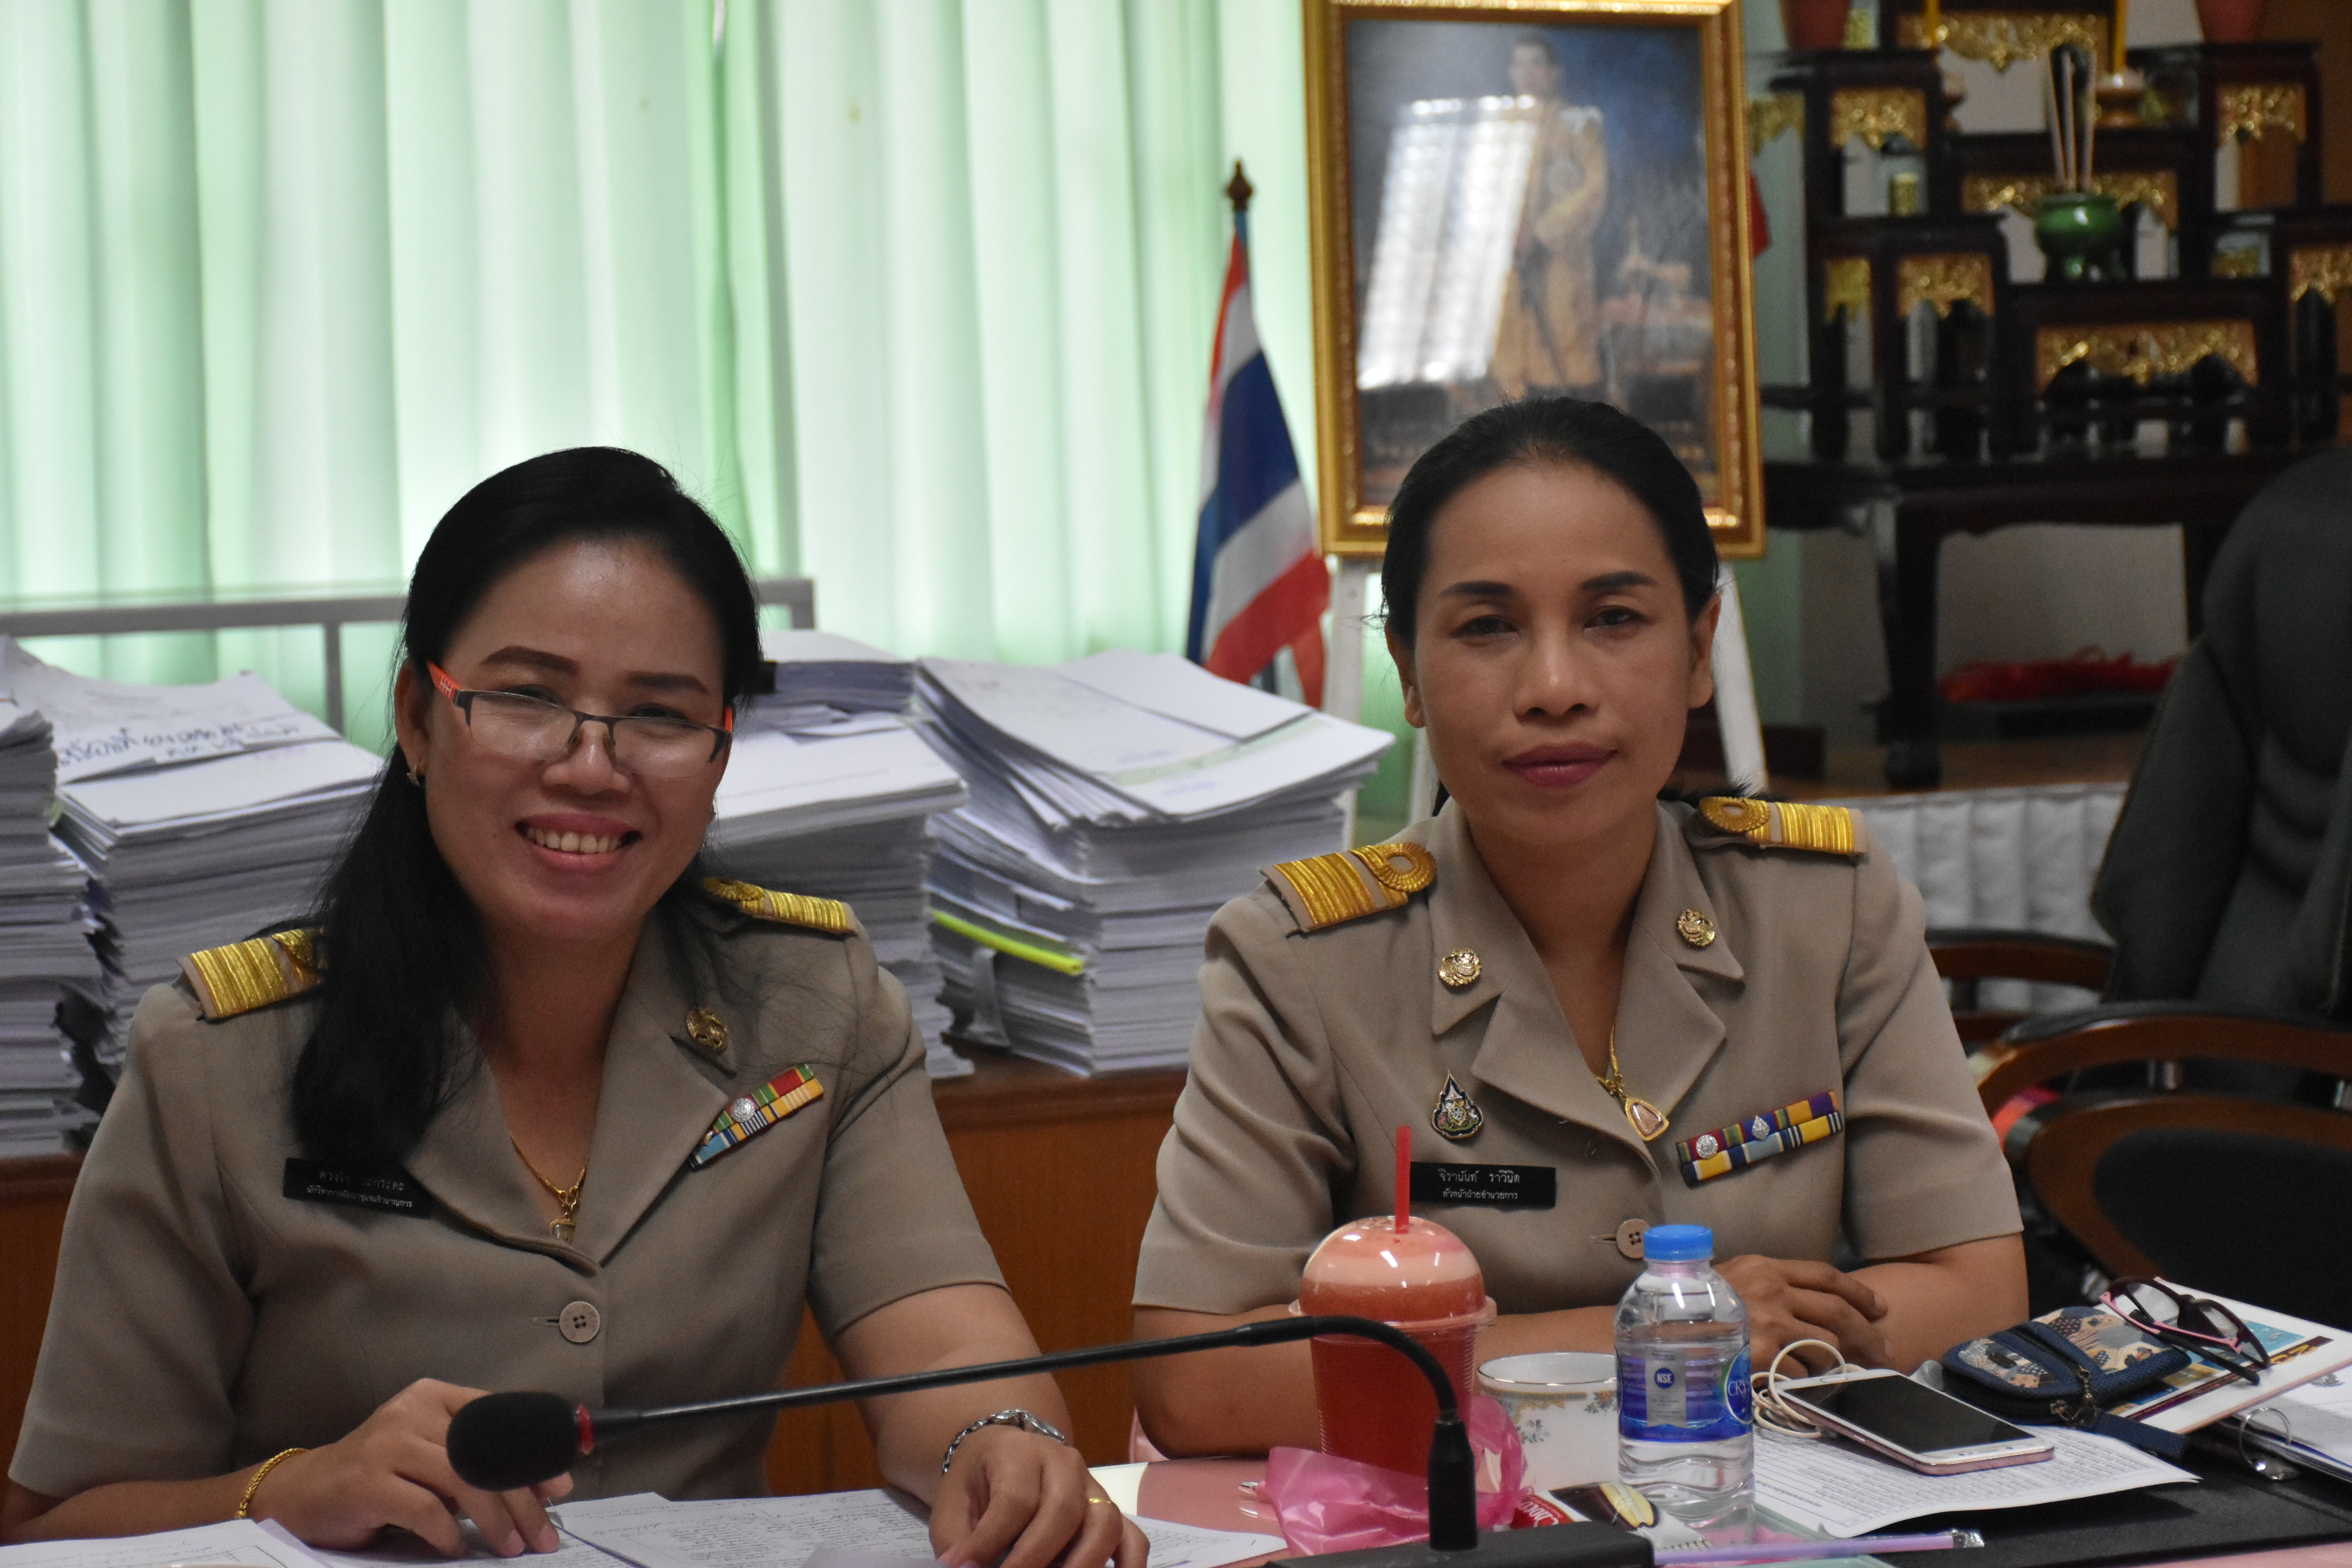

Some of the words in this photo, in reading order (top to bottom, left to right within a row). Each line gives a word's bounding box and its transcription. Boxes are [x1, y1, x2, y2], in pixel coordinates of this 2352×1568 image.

[1443, 1187, 1518, 1200] หัวหน้าฝ่ายอำนวยการ
[1657, 1374, 1673, 1384] NSF
